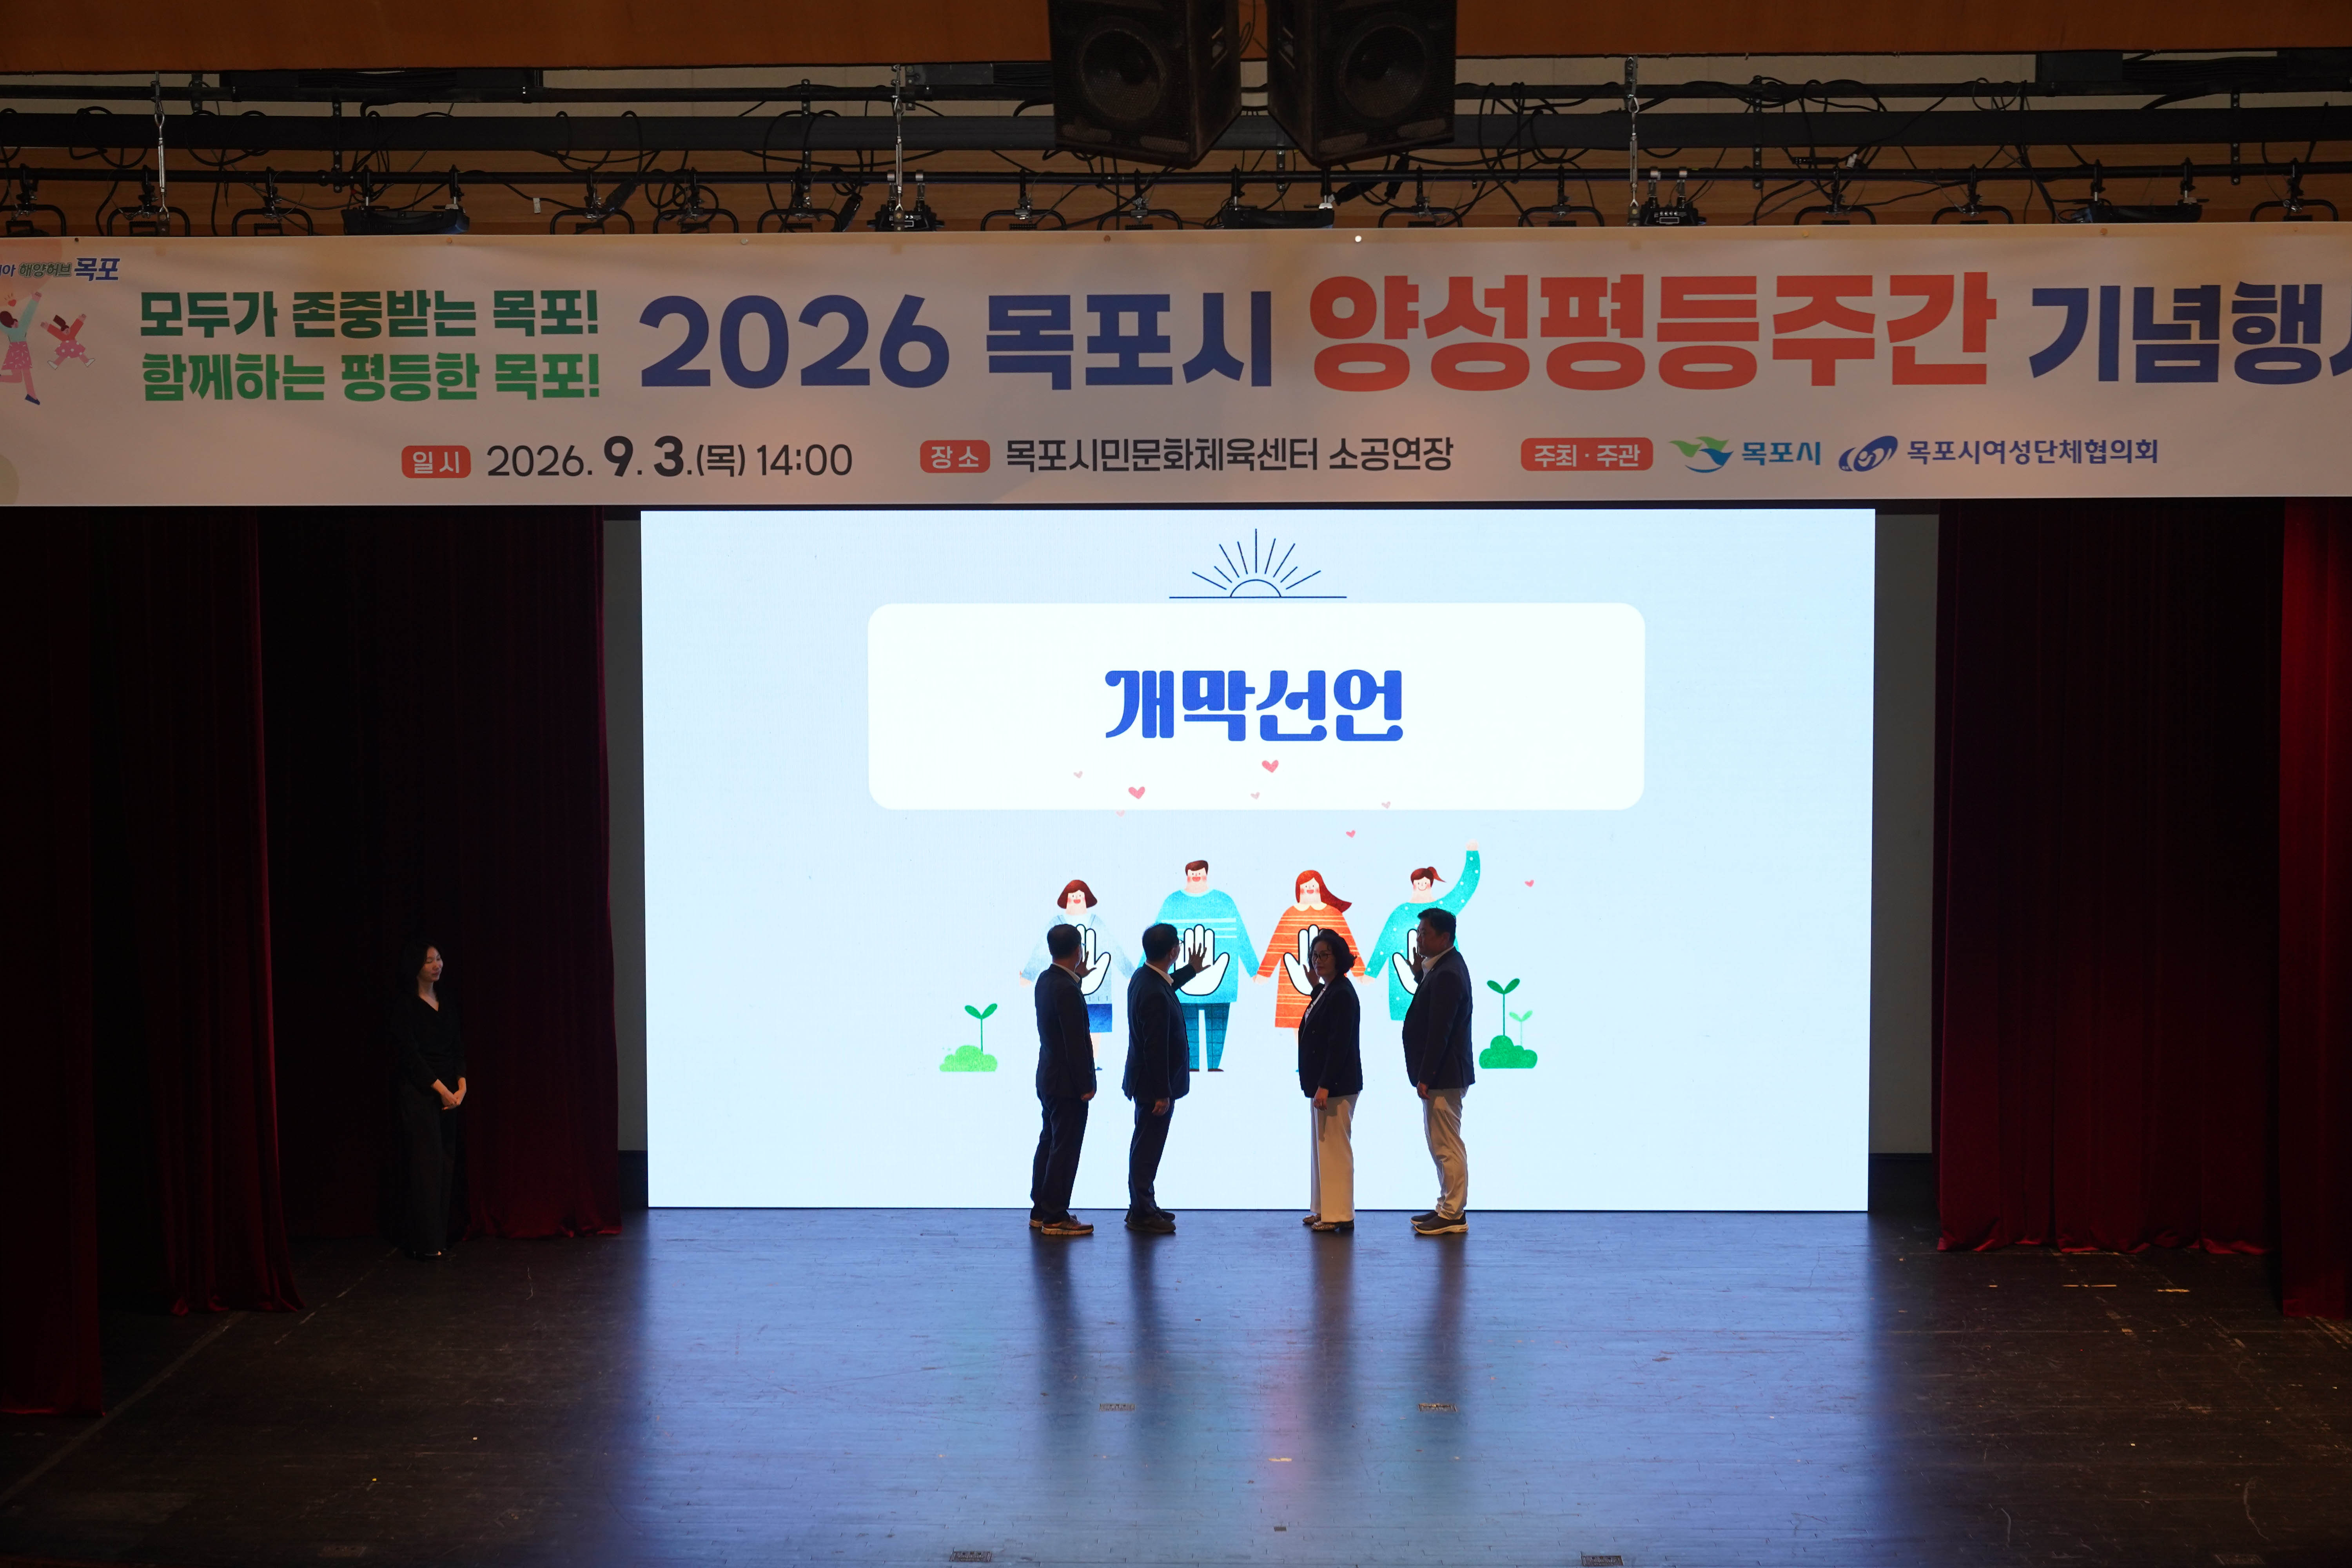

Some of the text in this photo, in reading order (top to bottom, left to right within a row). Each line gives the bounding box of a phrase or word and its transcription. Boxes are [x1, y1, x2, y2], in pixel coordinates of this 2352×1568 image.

[0, 258, 120, 281] 아 해양허브 목포
[141, 290, 597, 338] 모두가 존중받는 목포!
[639, 294, 949, 388] 2026
[987, 291, 1271, 390] 목포시
[1310, 272, 1996, 392] 양성평등주간
[143, 353, 599, 401] 함께하는 평등한 목포!
[413, 452, 459, 474] 일시
[487, 445, 592, 476] 2026.
[757, 444, 852, 475] 14:00
[931, 446, 978, 468] 장소
[1007, 437, 1453, 472] 목포시민문화체육센터 소공연장
[1535, 445, 1576, 467] 주최
[1597, 445, 1640, 467] 주관
[1742, 442, 1820, 465] 목포시
[1908, 439, 2157, 465] 목포시여성단체협의회
[1105, 670, 1403, 741] 개막선언
